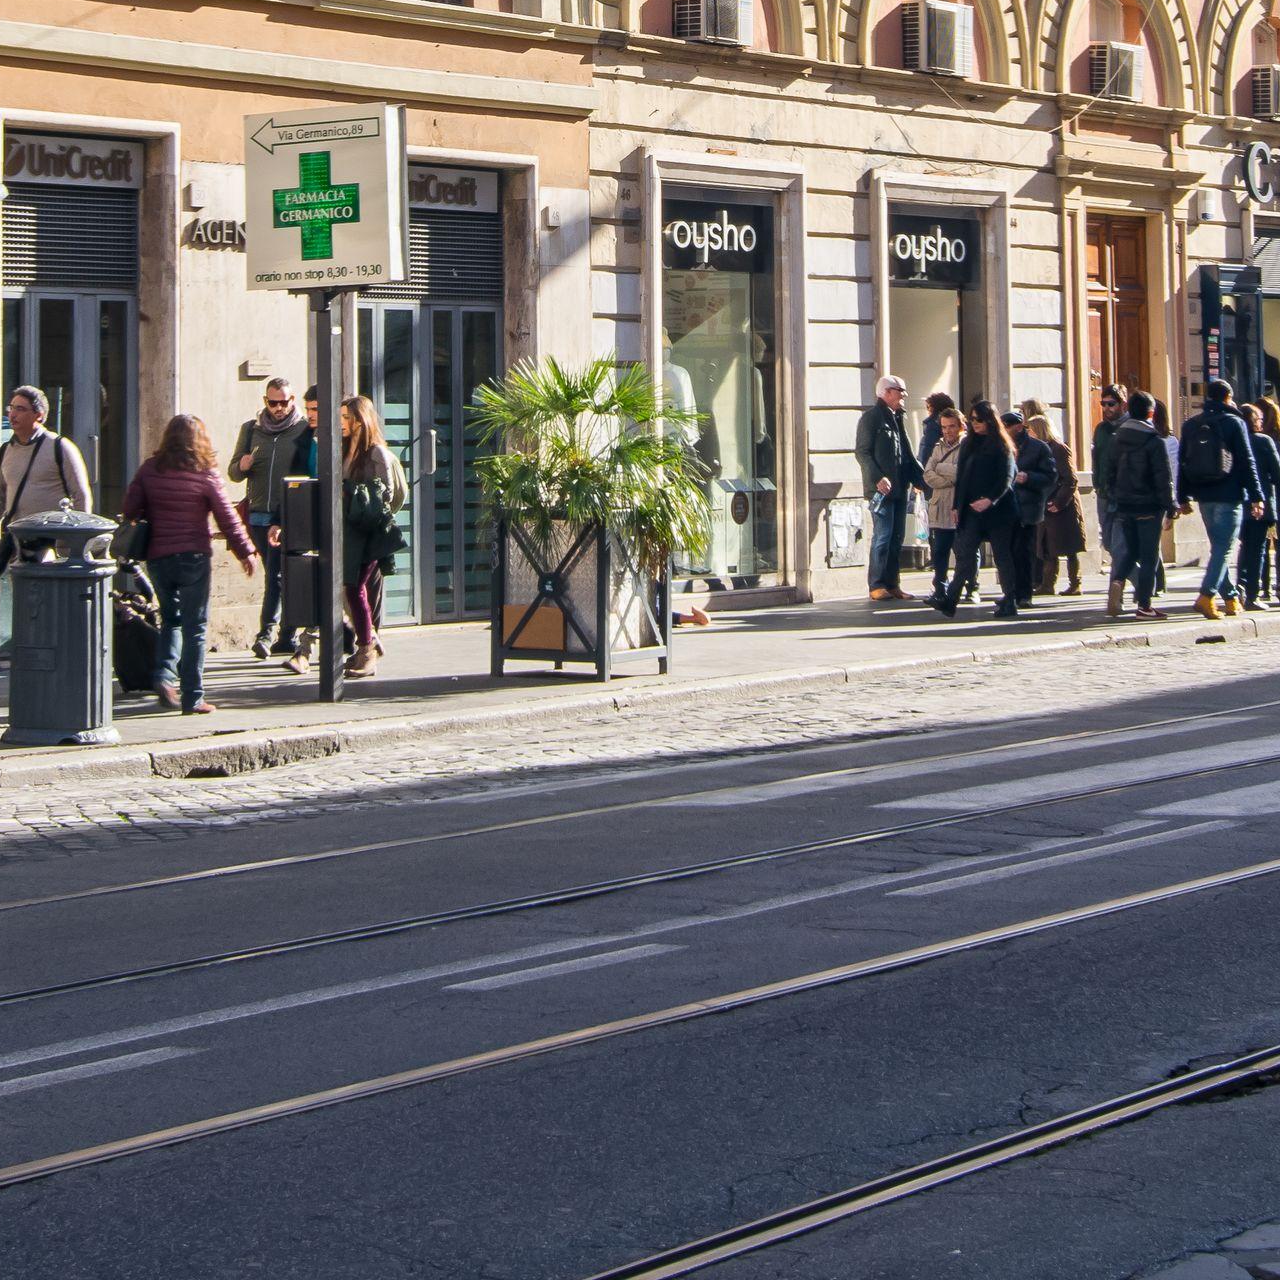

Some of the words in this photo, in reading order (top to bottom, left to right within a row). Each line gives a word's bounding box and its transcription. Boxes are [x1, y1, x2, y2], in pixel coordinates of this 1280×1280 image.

[278, 130, 293, 140] Via
[27, 142, 132, 182] UniCredit
[285, 189, 346, 205] FARMACIA
[409, 174, 477, 207] niCredit
[279, 206, 353, 223] GERMANICO
[192, 218, 248, 244] AGEN
[673, 209, 756, 263] oysho
[895, 226, 965, 273] oysho
[255, 271, 282, 282] orario
[284, 270, 302, 280] non
[304, 268, 324, 280] stop
[327, 266, 348, 280] 8,30
[356, 264, 382, 277] 19,30
